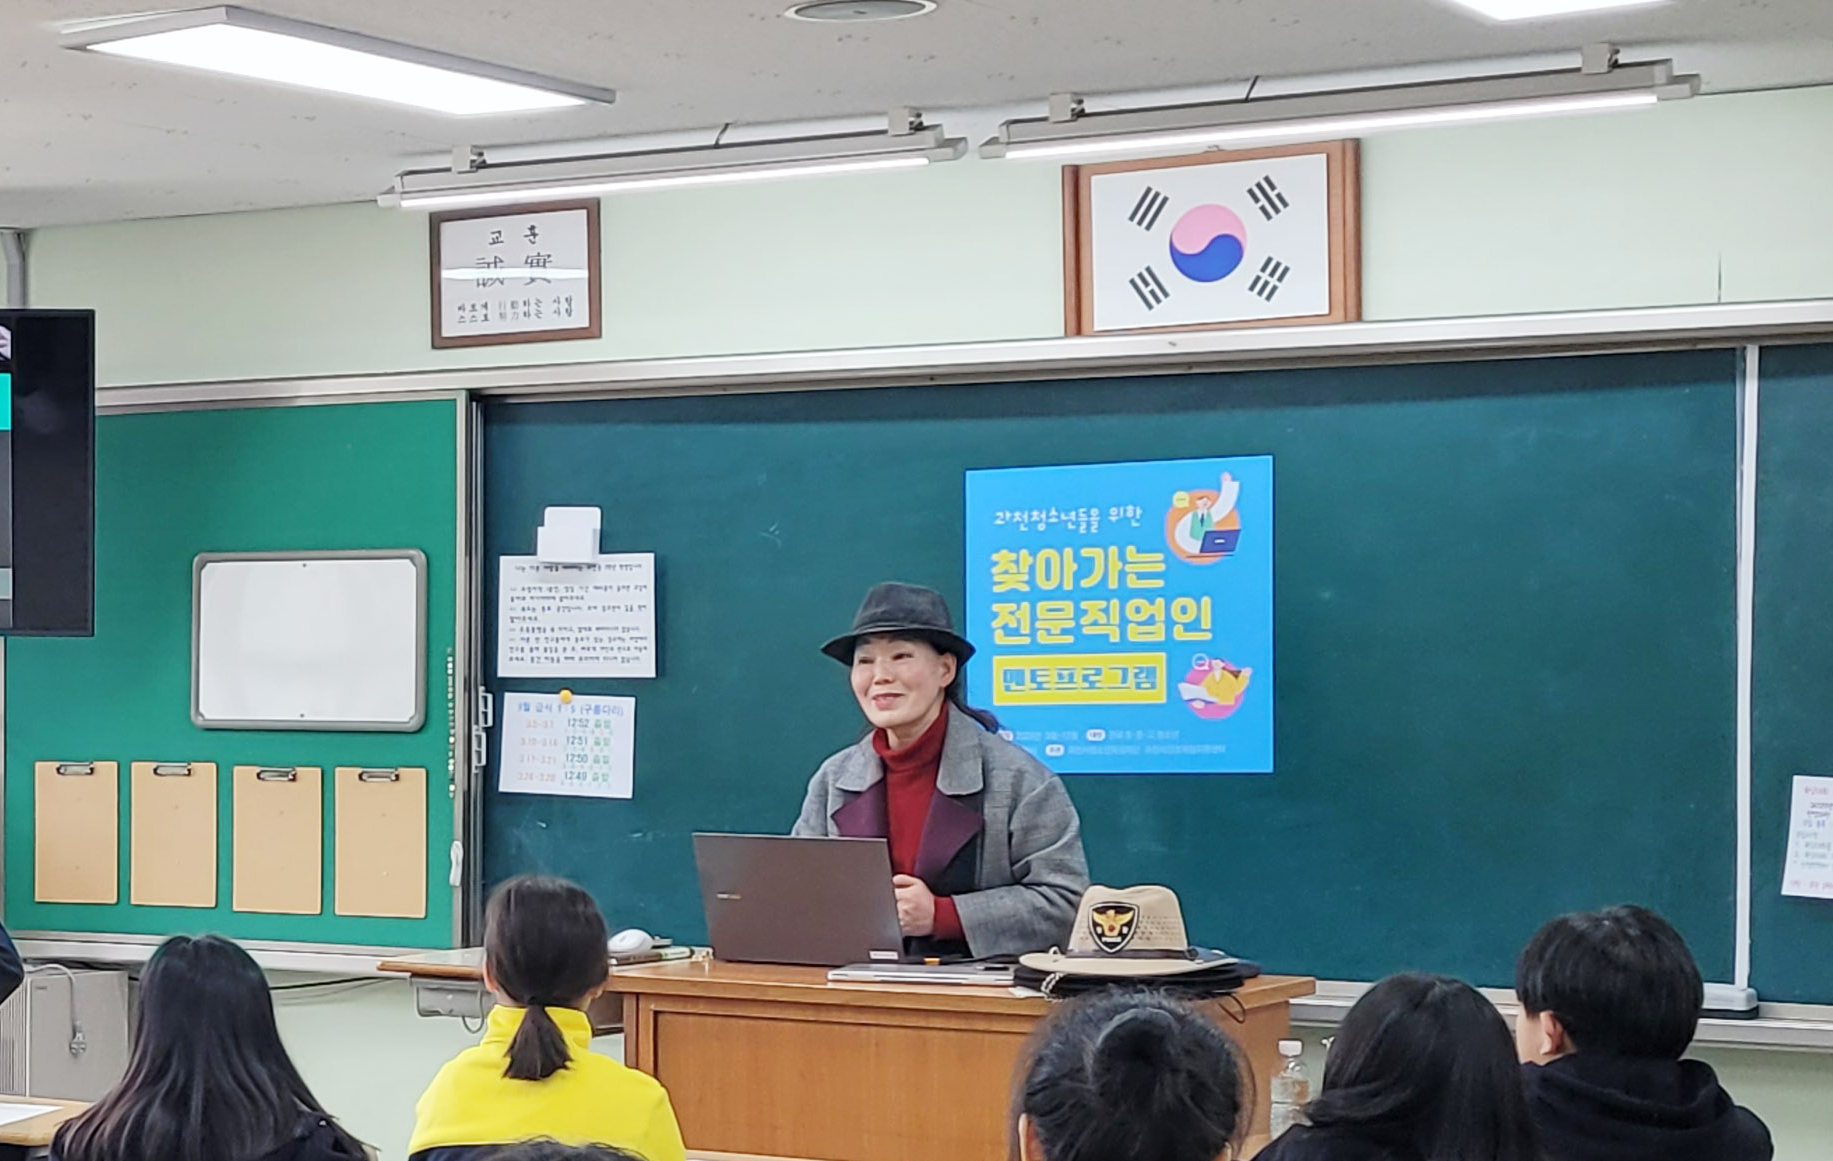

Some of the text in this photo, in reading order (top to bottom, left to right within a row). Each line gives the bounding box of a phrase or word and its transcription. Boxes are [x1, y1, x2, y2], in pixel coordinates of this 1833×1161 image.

[993, 505, 1143, 534] 과천청소년들을 위한
[990, 545, 1166, 593] 찾아가는
[990, 596, 1213, 645] 전문직업인
